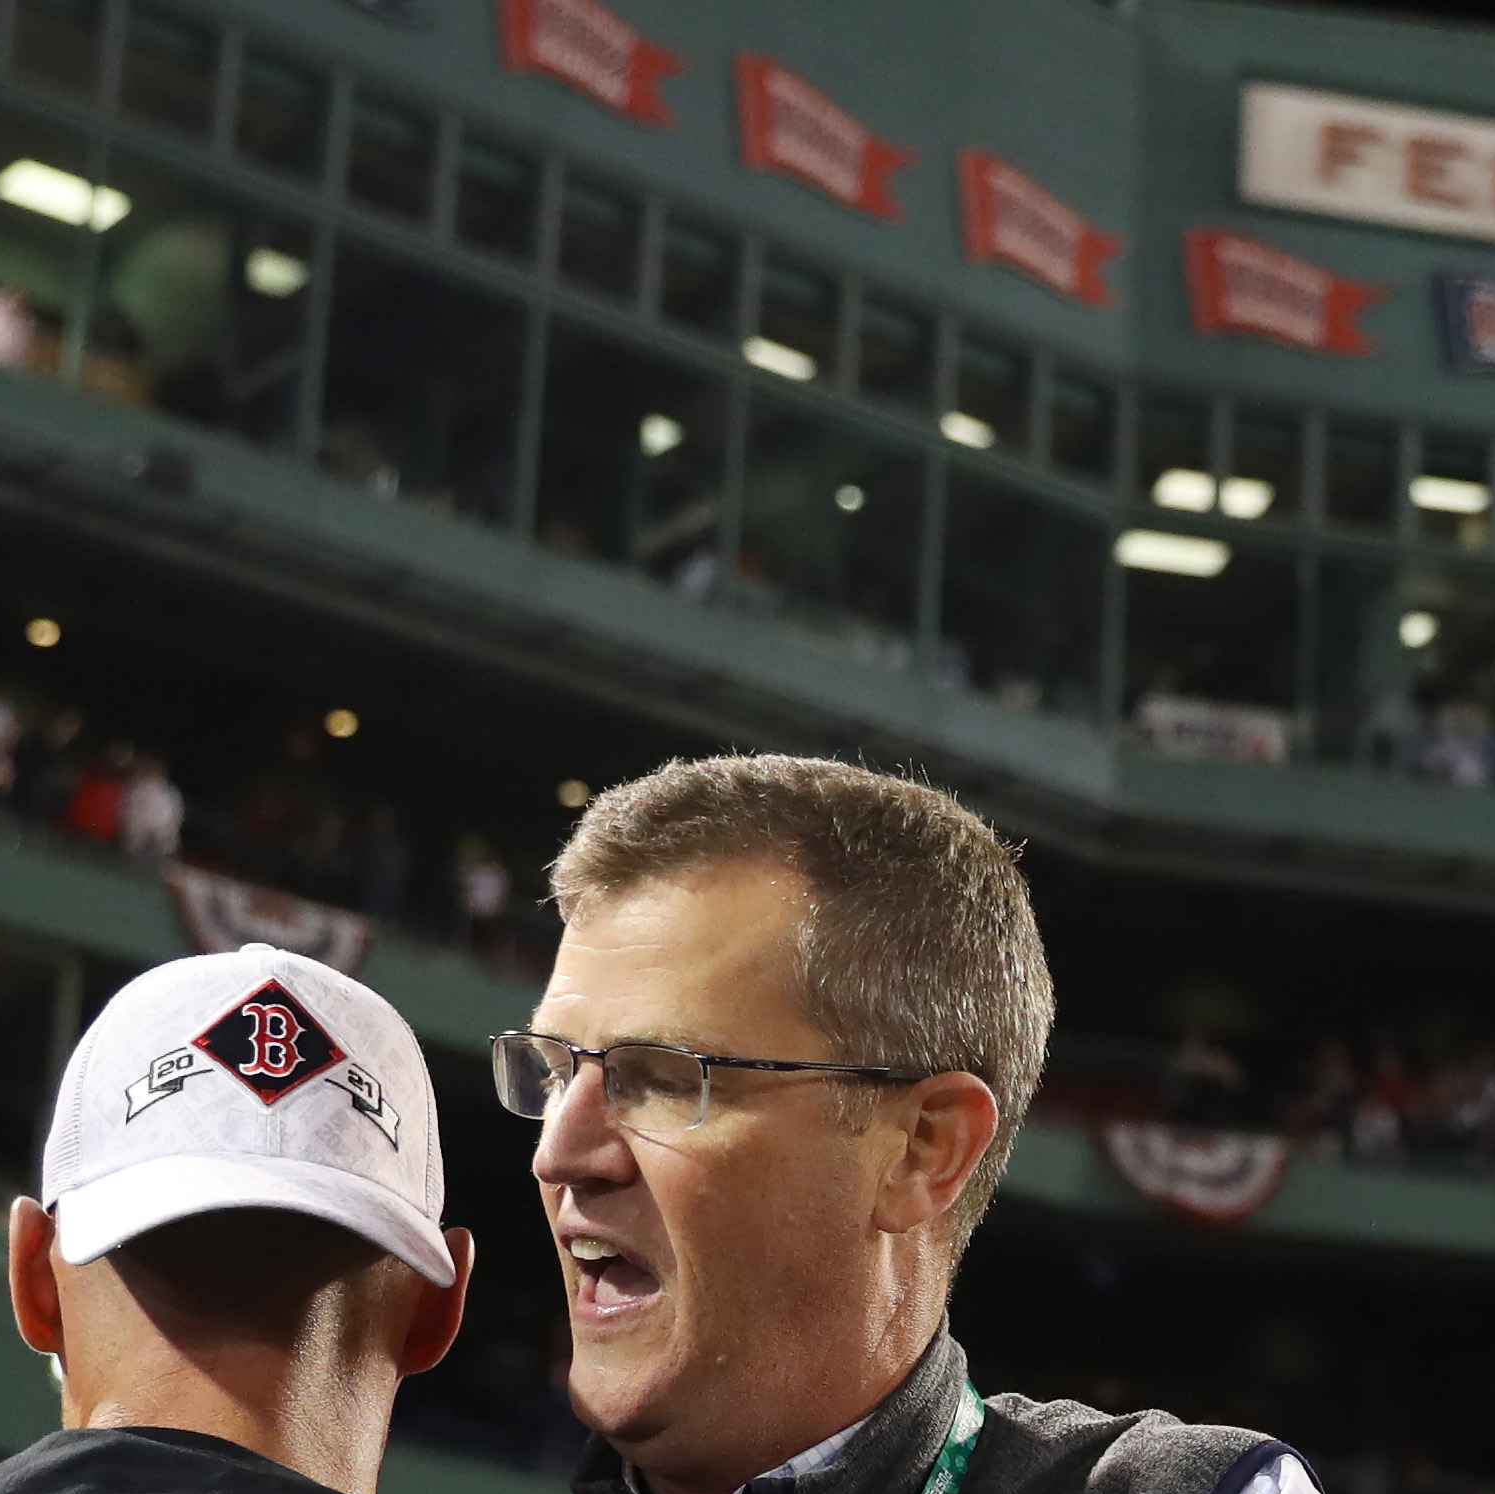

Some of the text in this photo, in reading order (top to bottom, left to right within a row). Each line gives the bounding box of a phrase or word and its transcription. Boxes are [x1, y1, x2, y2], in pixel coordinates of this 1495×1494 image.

[238, 1004, 306, 1077] B
[157, 1053, 194, 1079] 20
[348, 1069, 374, 1098] 21
